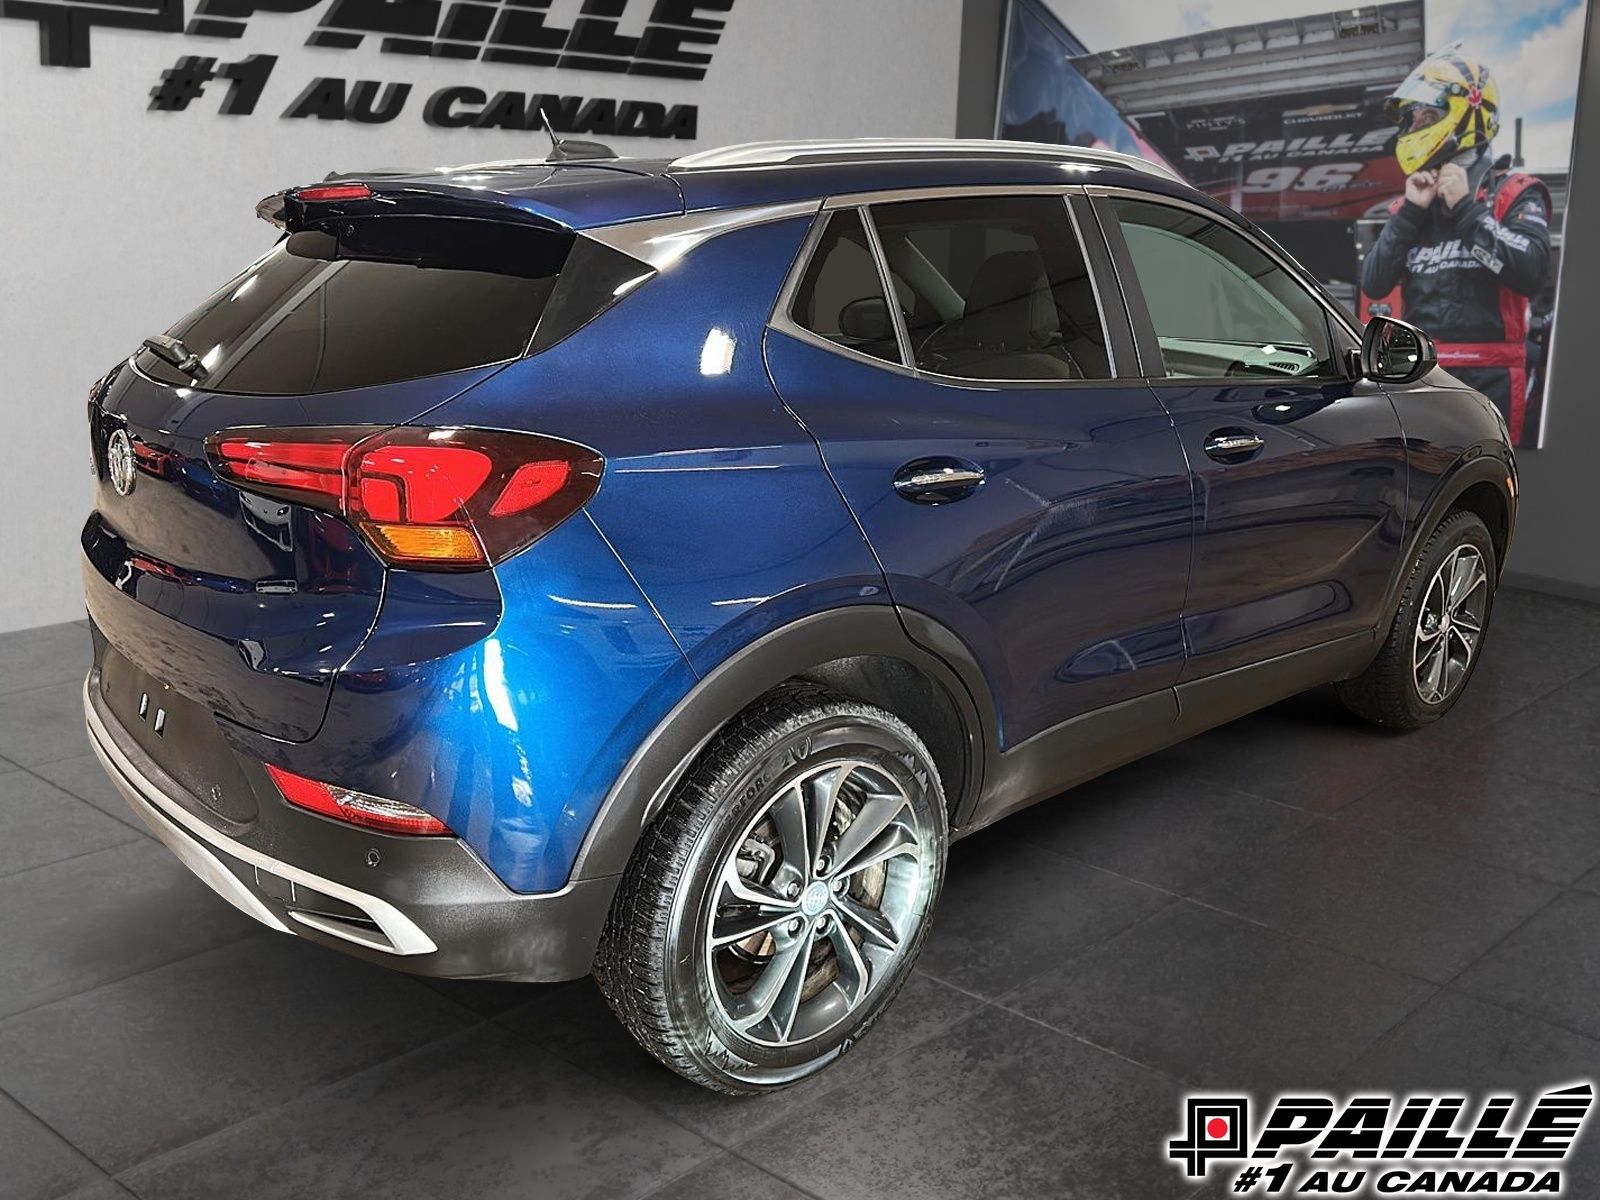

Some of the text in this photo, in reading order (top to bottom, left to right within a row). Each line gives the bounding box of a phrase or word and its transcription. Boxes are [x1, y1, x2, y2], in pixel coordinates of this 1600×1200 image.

[147, 54, 698, 140] #1 AU CANADA
[1284, 112, 1363, 125] CHEVROLET
[1286, 145, 1384, 158] CANADA
[1242, 162, 1364, 193] 96
